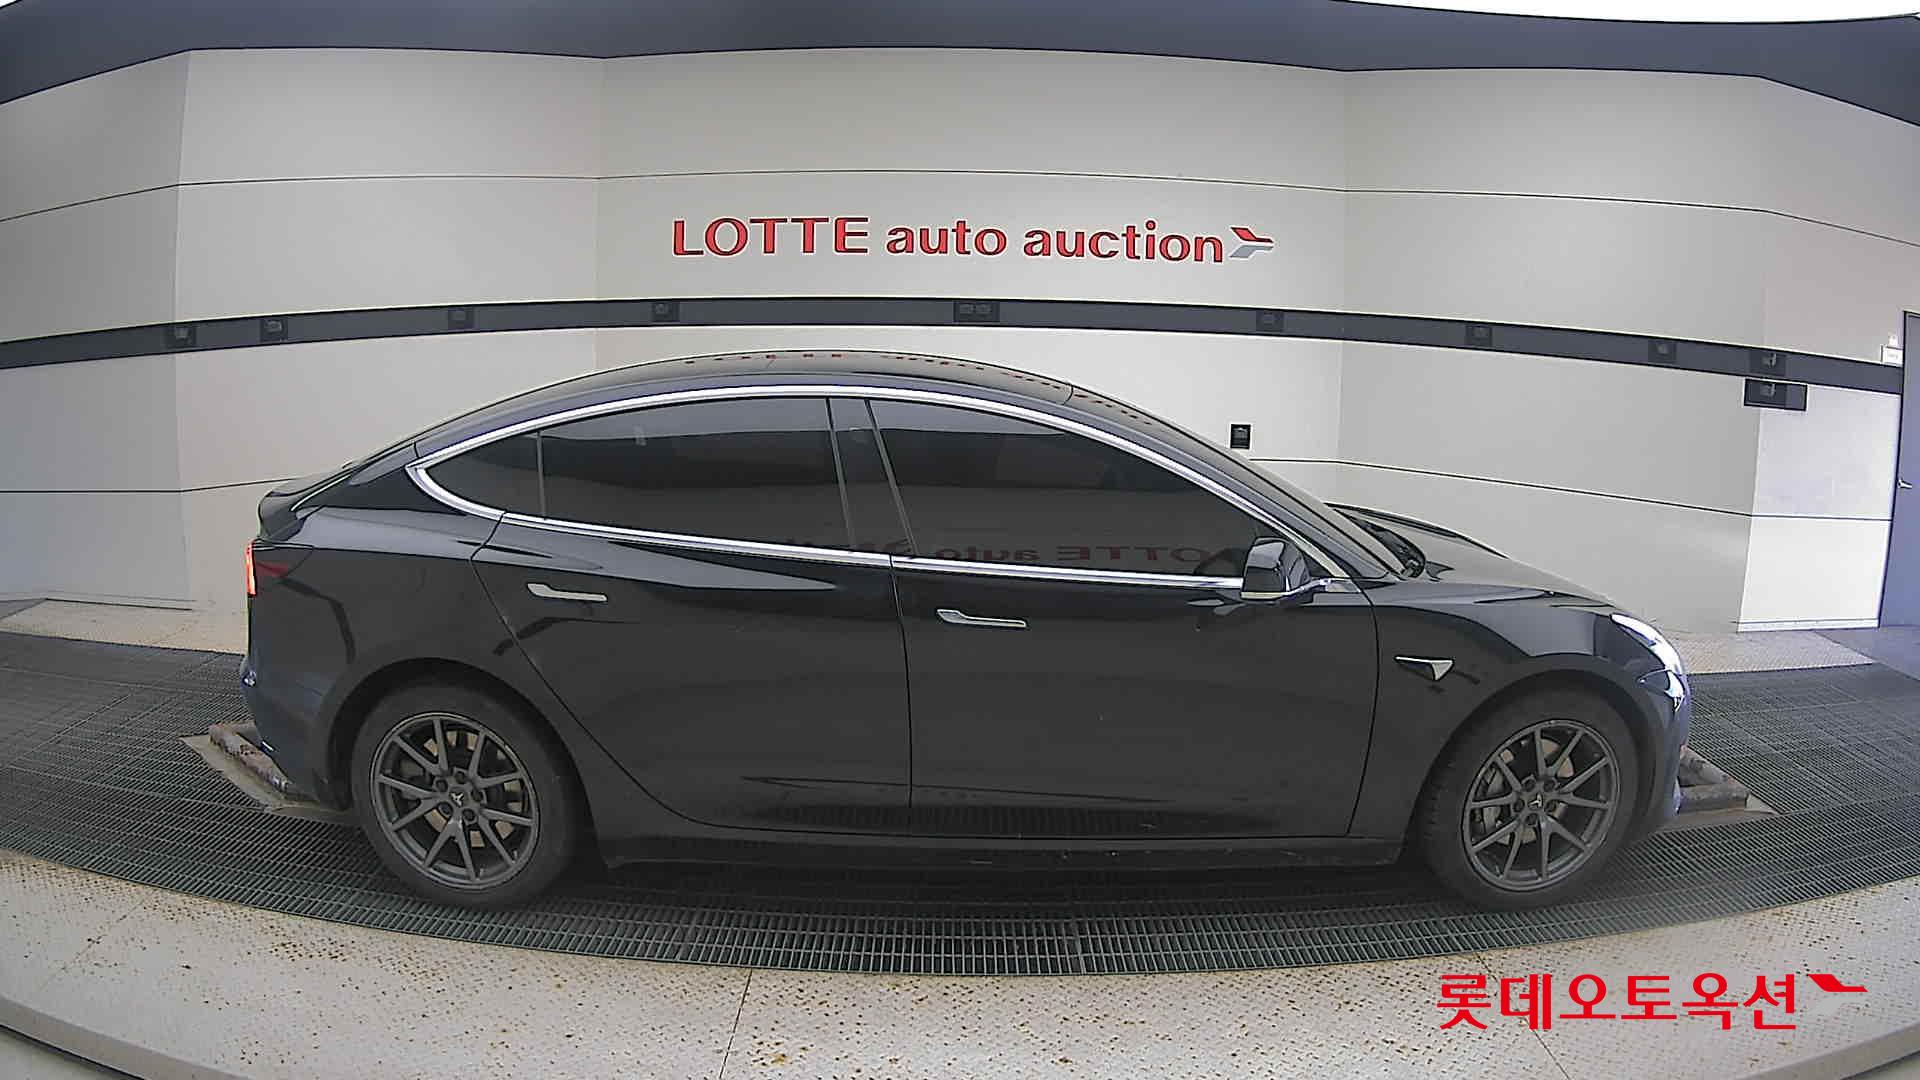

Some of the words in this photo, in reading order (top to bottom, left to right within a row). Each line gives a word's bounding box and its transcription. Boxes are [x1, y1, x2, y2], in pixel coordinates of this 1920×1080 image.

[672, 216, 868, 257] LOTTE
[886, 220, 1008, 255] auto
[1023, 220, 1224, 263] auction
